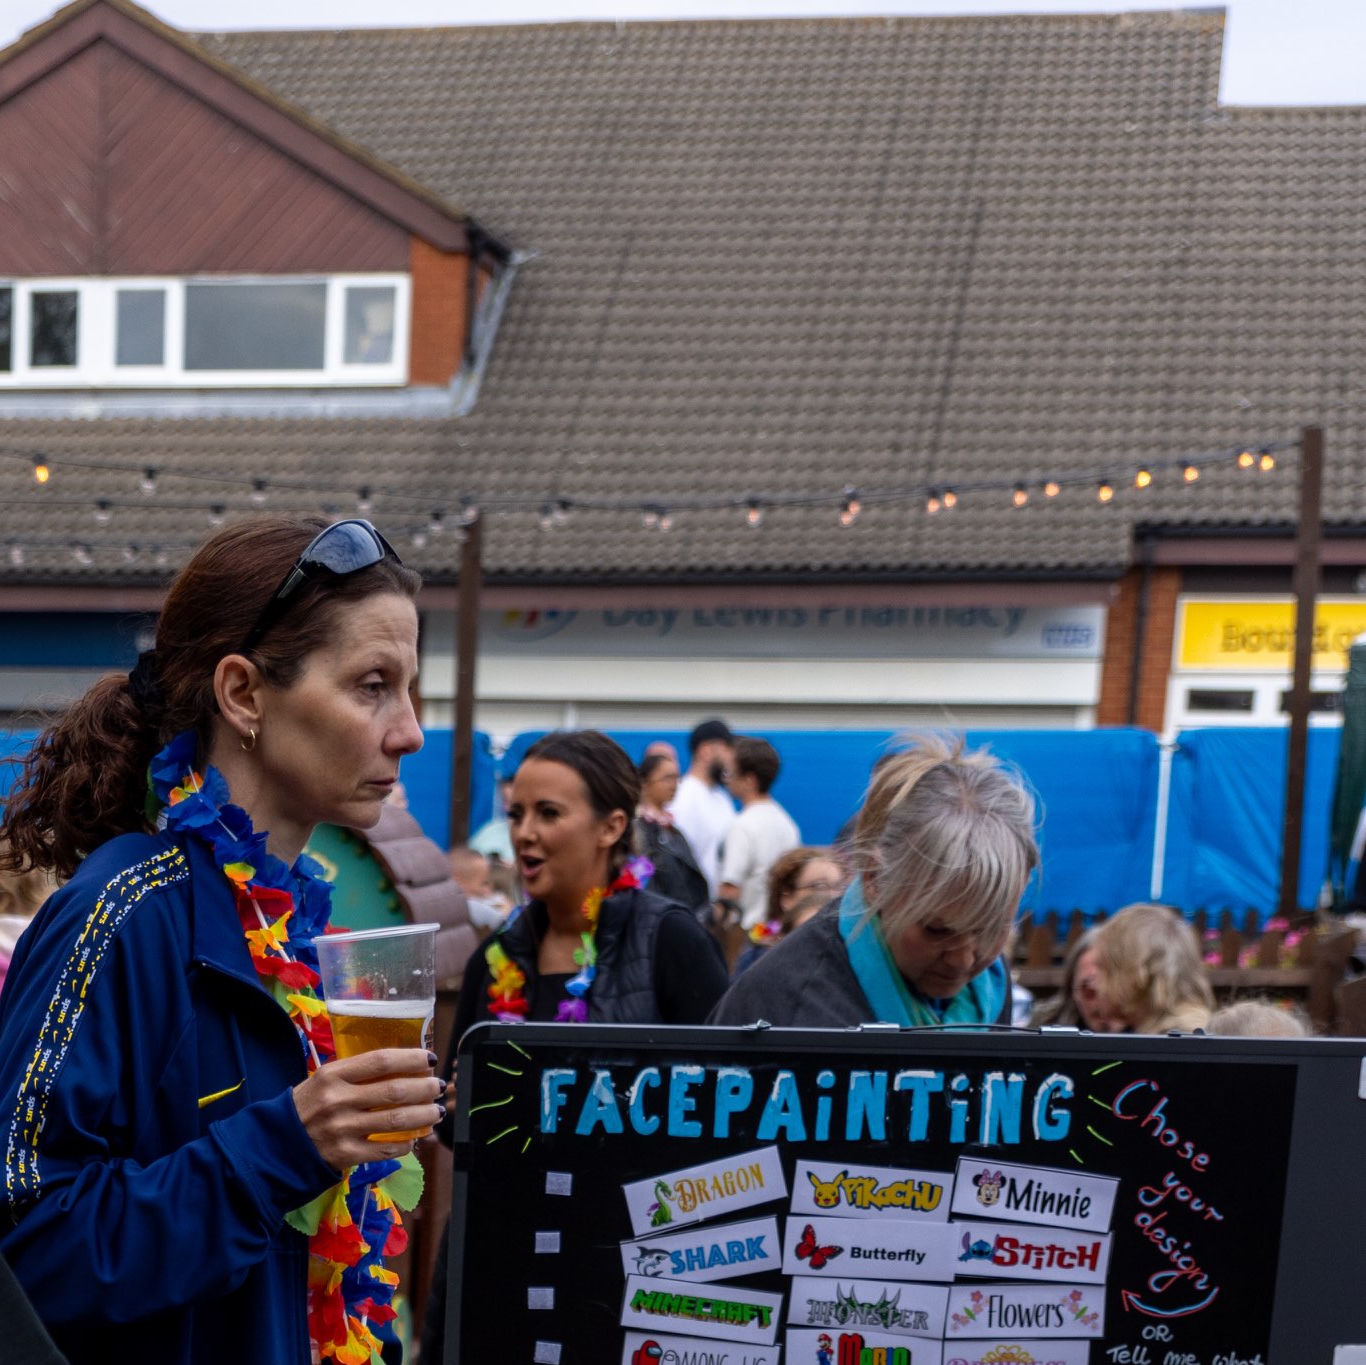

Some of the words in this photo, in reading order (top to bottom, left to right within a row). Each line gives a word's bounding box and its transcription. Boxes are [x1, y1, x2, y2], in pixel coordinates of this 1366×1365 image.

[1112, 1079, 1210, 1172] Chose
[1005, 1177, 1091, 1219] Minnie
[1137, 1171, 1224, 1221] your
[670, 1235, 769, 1275] SHARK
[850, 1246, 926, 1265] Butterfly
[1134, 1211, 1209, 1293] design
[630, 1288, 774, 1329] MINECRAFT
[987, 1295, 1065, 1328] Flowers
[1141, 1324, 1174, 1342] OR
[1106, 1344, 1151, 1365] Tell
